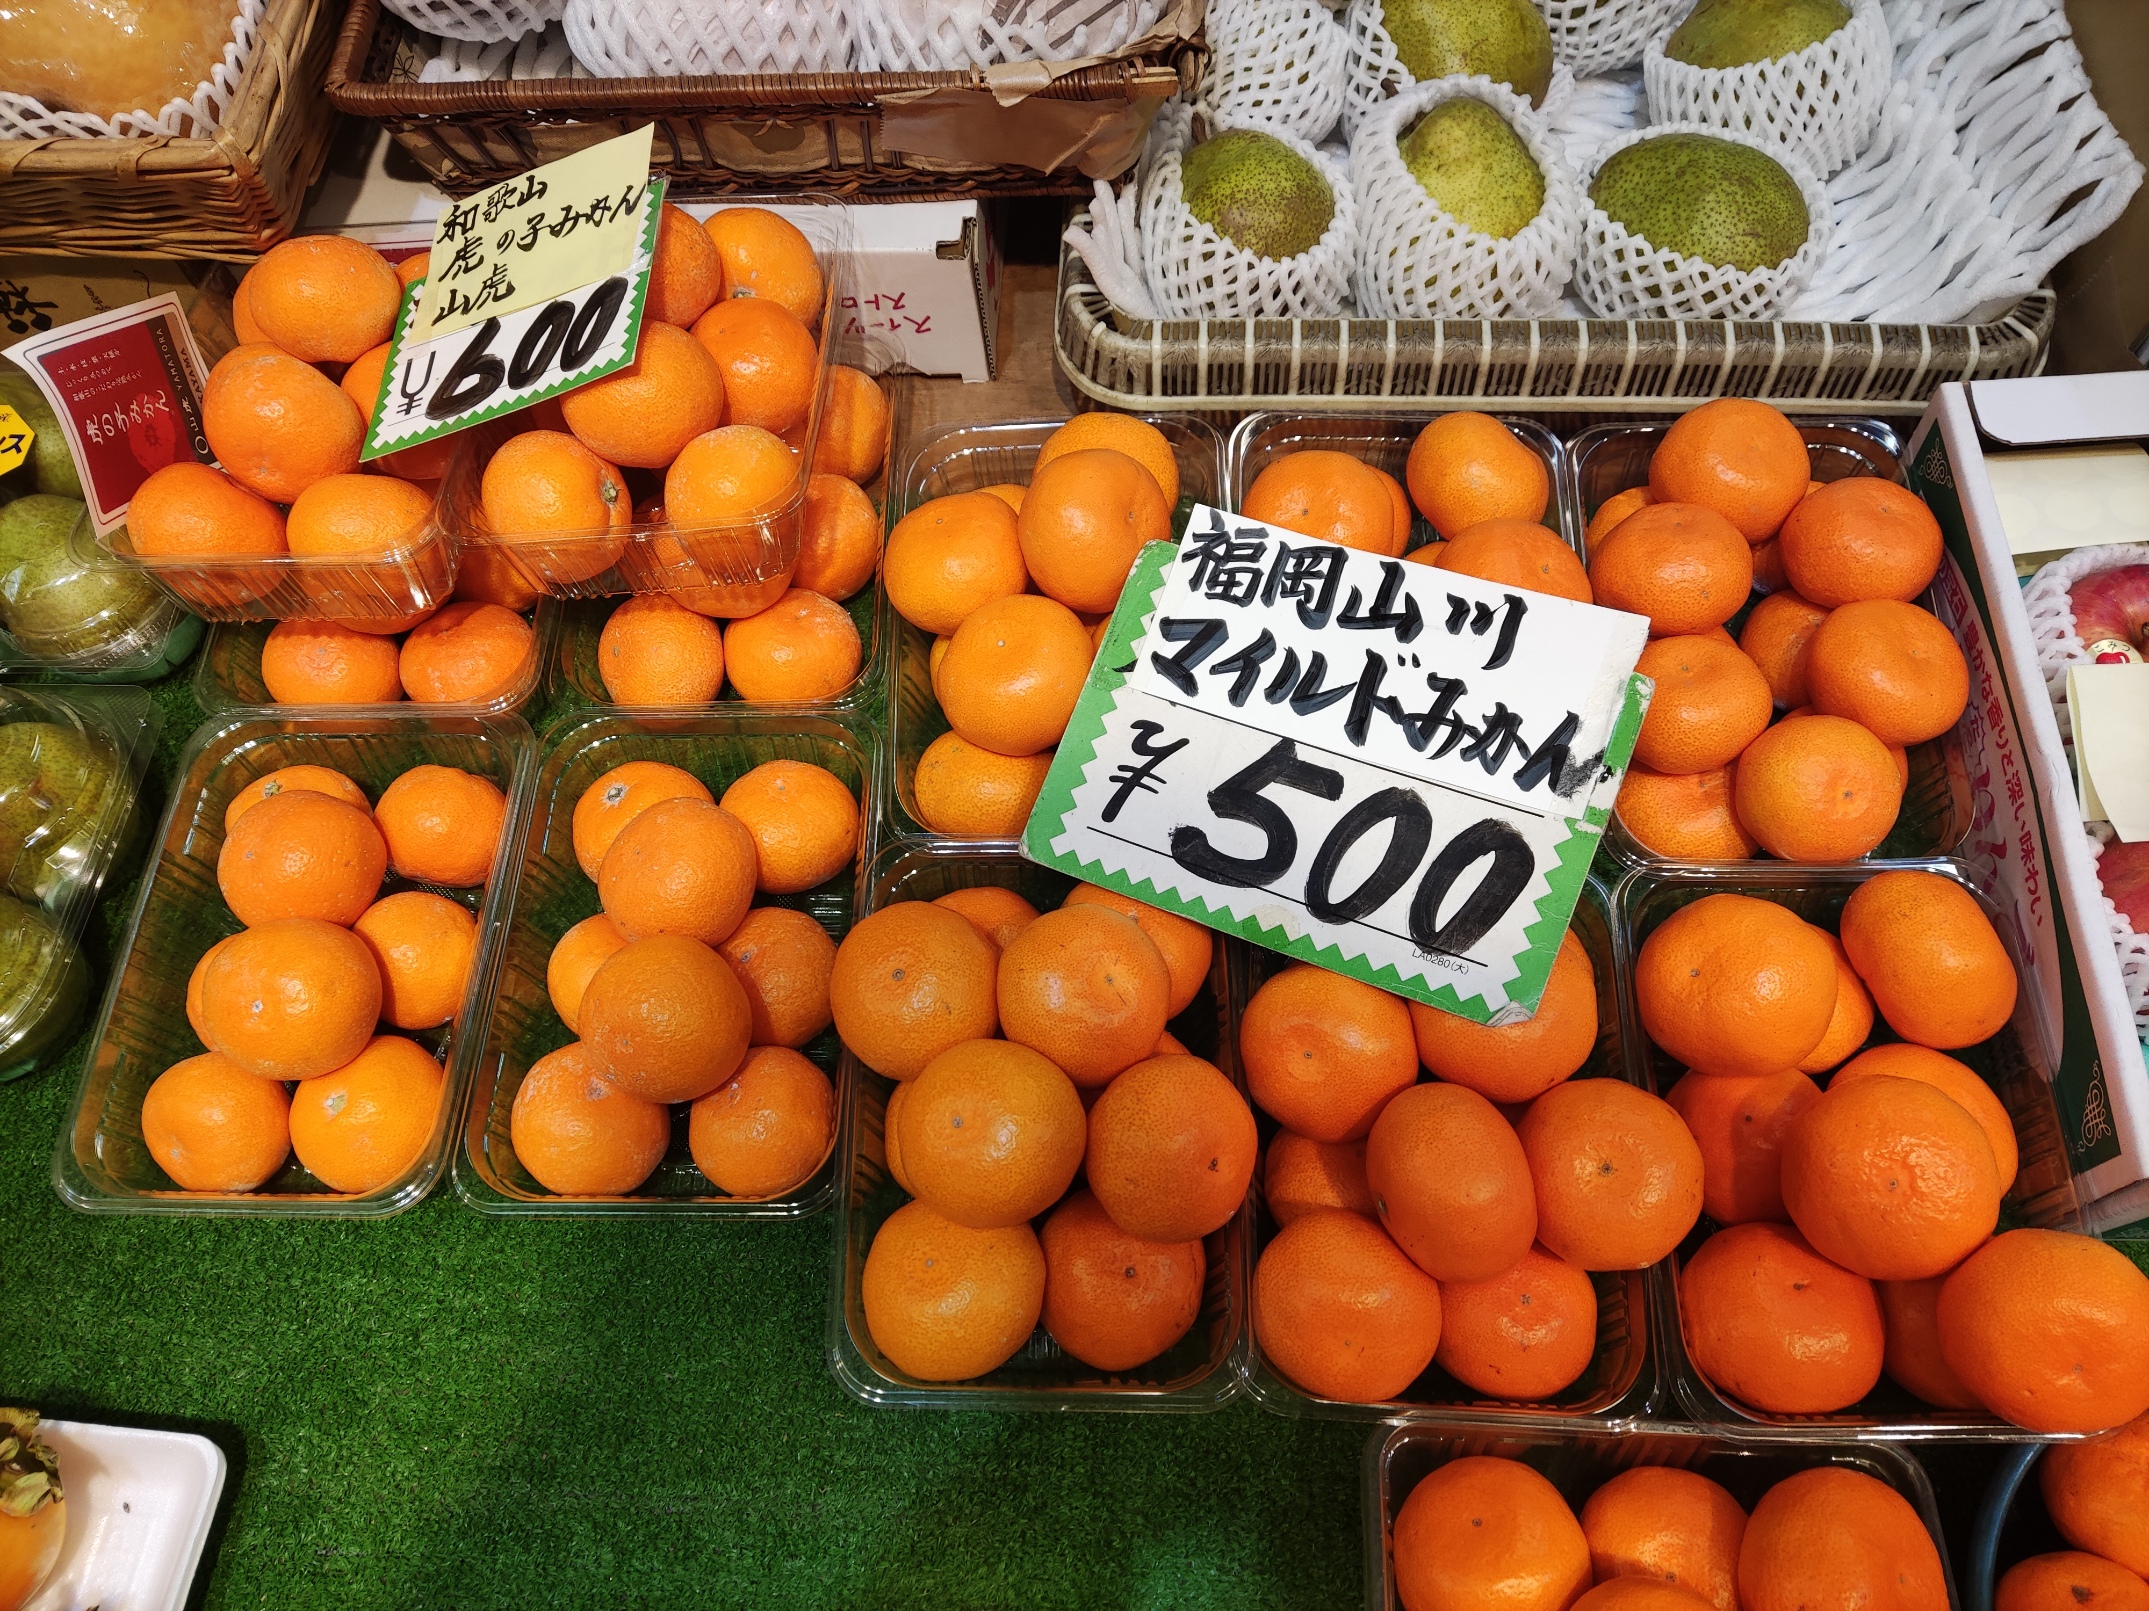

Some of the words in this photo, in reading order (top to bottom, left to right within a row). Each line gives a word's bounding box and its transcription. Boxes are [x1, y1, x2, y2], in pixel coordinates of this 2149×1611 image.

[437, 175, 548, 244] 和歌山
[438, 183, 647, 282] 虎の子みかん
[431, 263, 515, 326] 山虎
[156, 328, 182, 391] YAMATORA
[85, 389, 170, 445] 虎の子みかん
[1181, 507, 1528, 670] 福岡山川
[2094, 640, 2131, 653] こみつ
[1151, 616, 1607, 795] マイルドみかん
[1963, 618, 2043, 927] 豊かな香りと深い味わい
